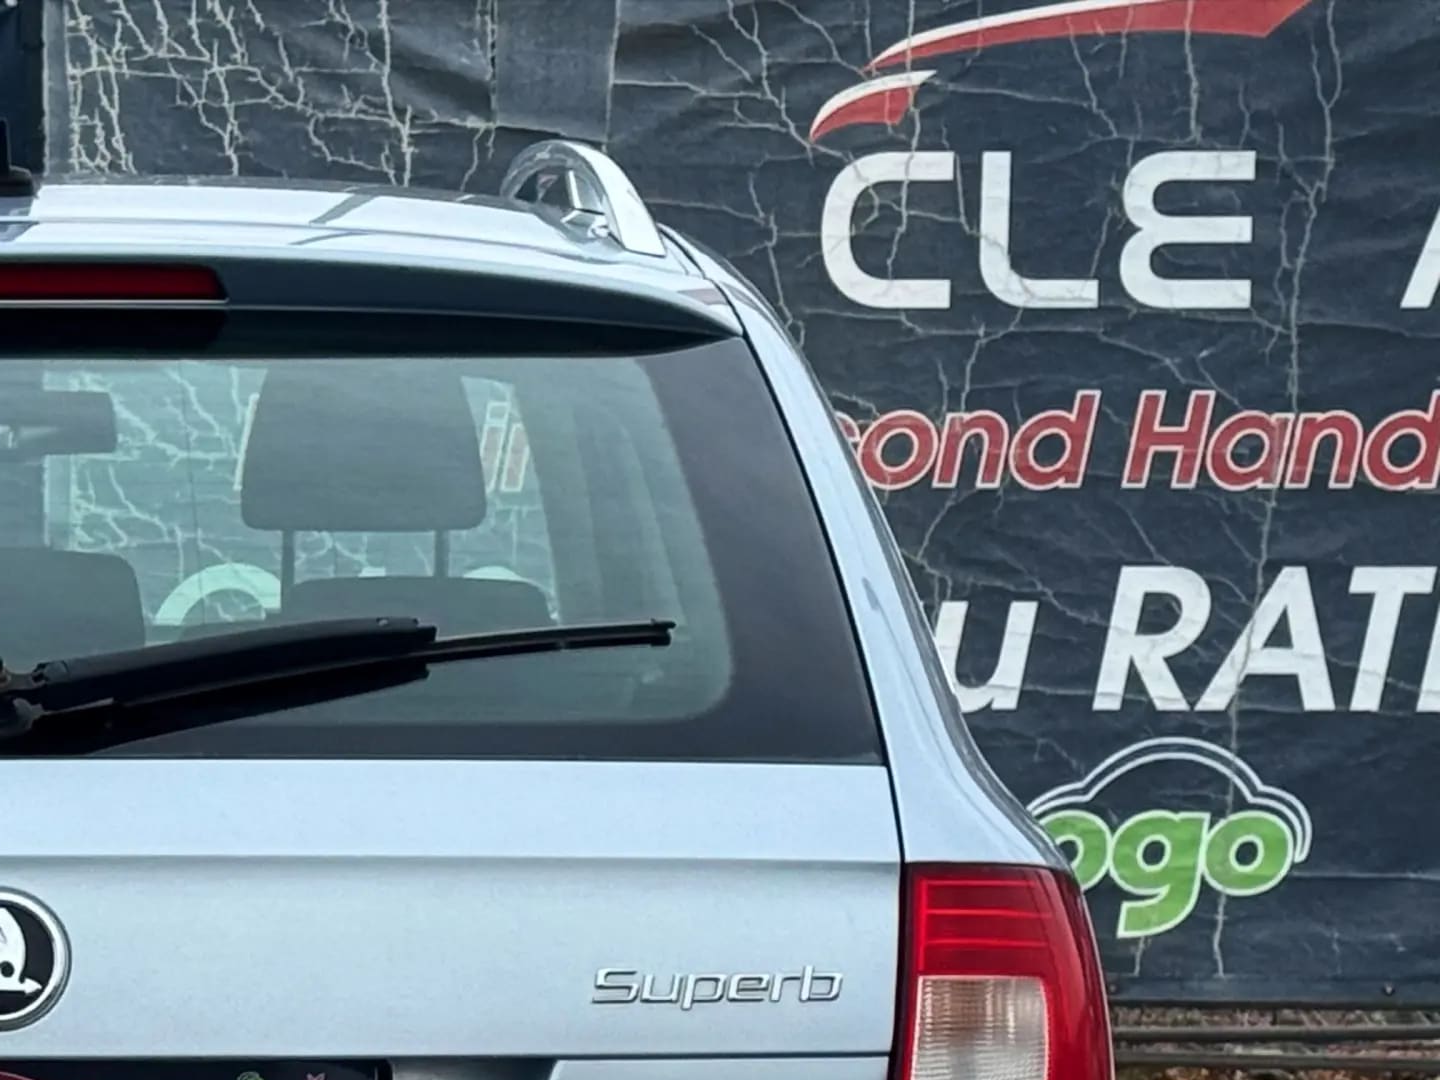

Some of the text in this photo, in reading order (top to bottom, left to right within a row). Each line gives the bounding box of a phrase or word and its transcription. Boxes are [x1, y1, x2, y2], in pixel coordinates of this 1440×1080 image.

[821, 150, 1257, 310] CLE
[1121, 389, 1440, 491] Hand
[591, 965, 844, 1011] Superb
